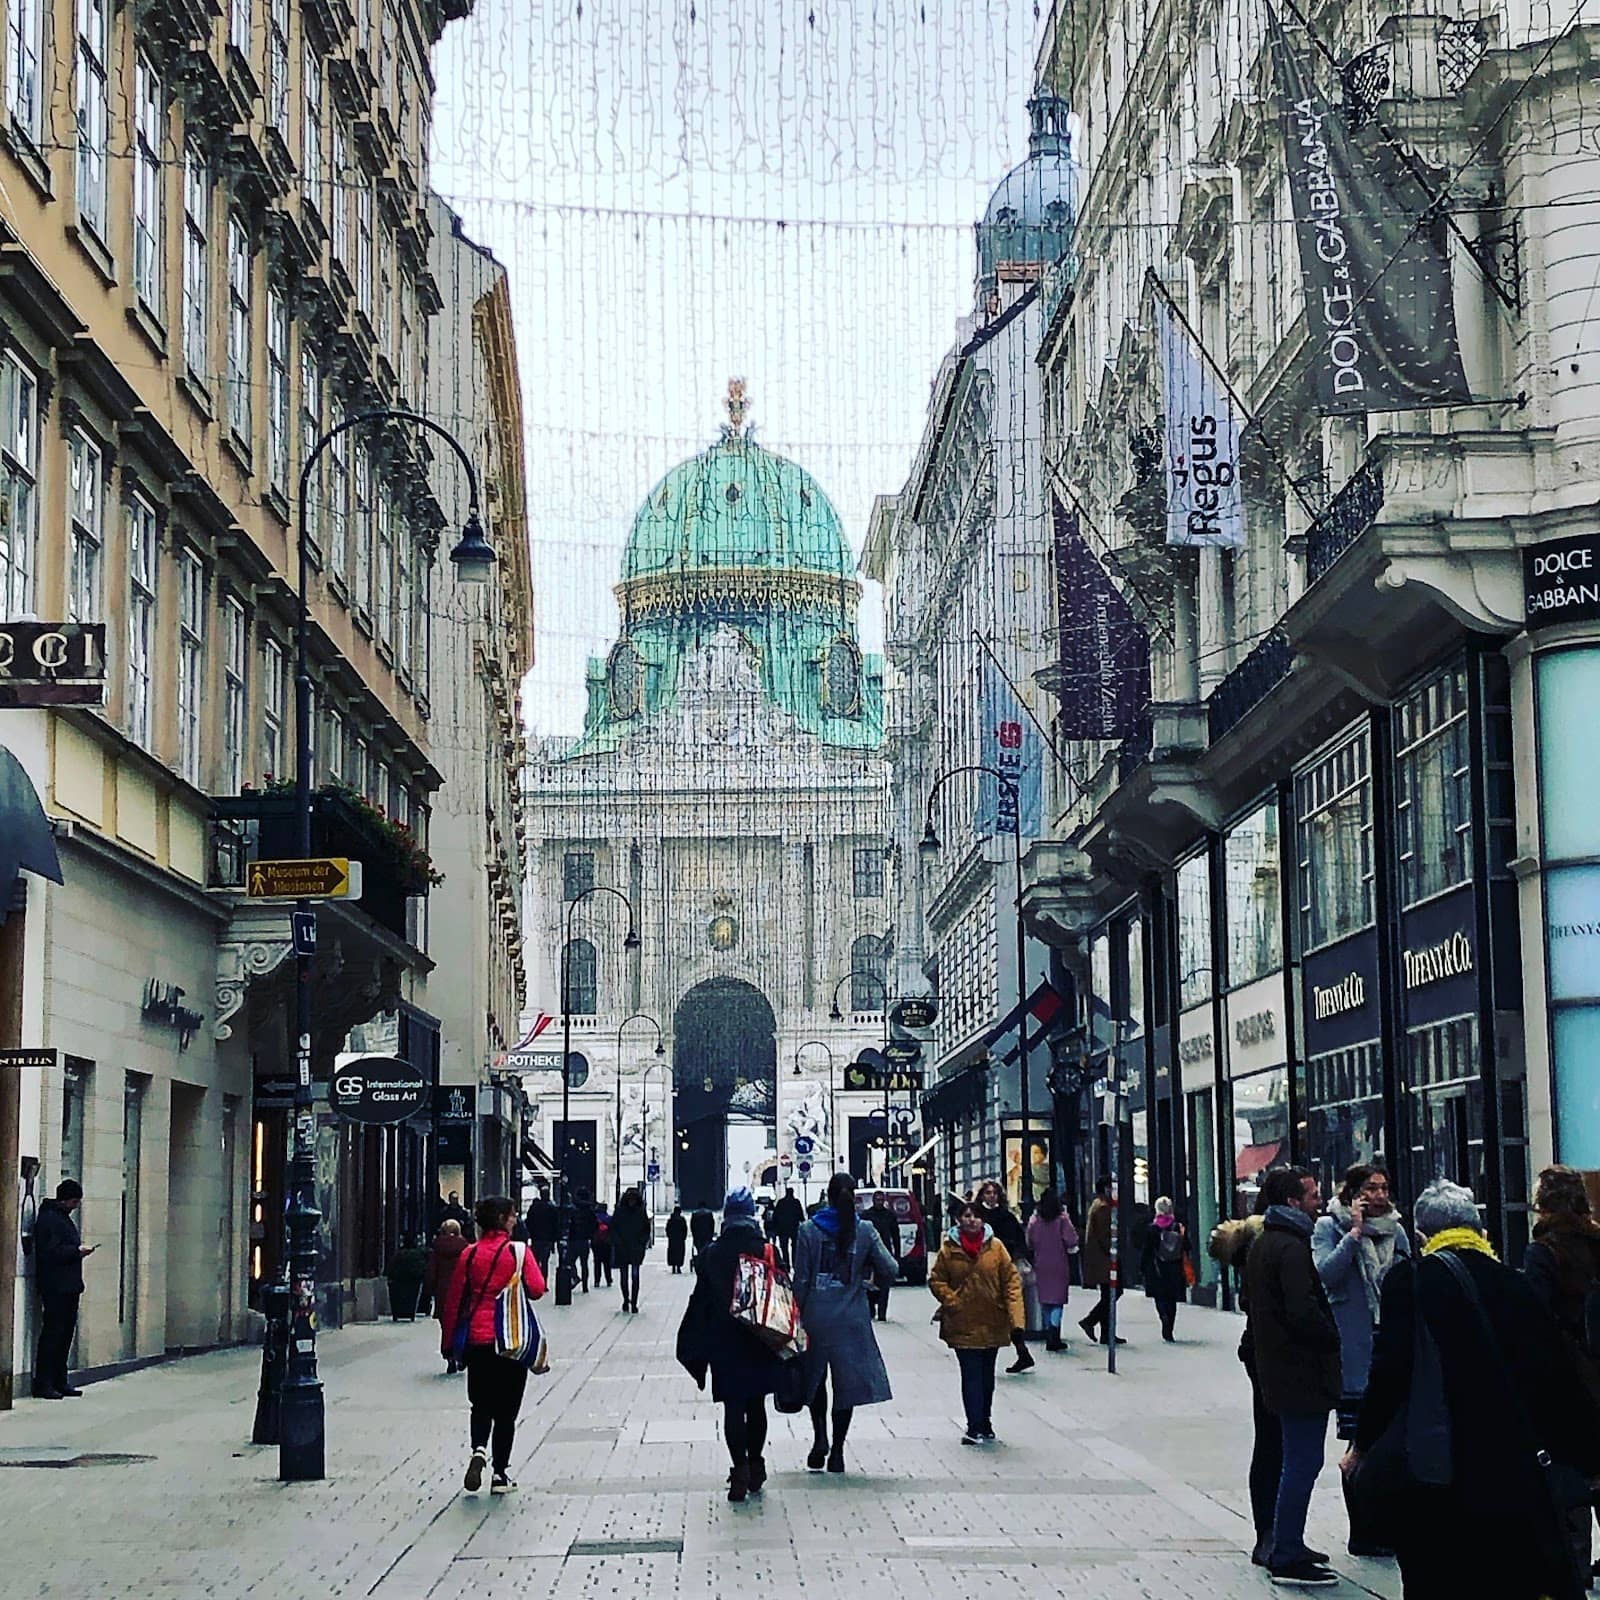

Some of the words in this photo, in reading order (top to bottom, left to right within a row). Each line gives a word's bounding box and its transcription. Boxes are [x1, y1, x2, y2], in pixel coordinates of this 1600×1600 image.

[1294, 100, 1347, 262] GABBANA
[1334, 265, 1349, 279] &
[1323, 284, 1364, 394] DOLCE
[1188, 416, 1234, 534] Regus
[1534, 549, 1593, 576] DOLCE
[1527, 583, 1600, 614] GABBAN
[492, 1053, 562, 1067] APOTHEKE
[336, 1076, 363, 1096] GS
[366, 1079, 423, 1089] International
[372, 1091, 400, 1101] Glass
[401, 1091, 417, 1101] Art
